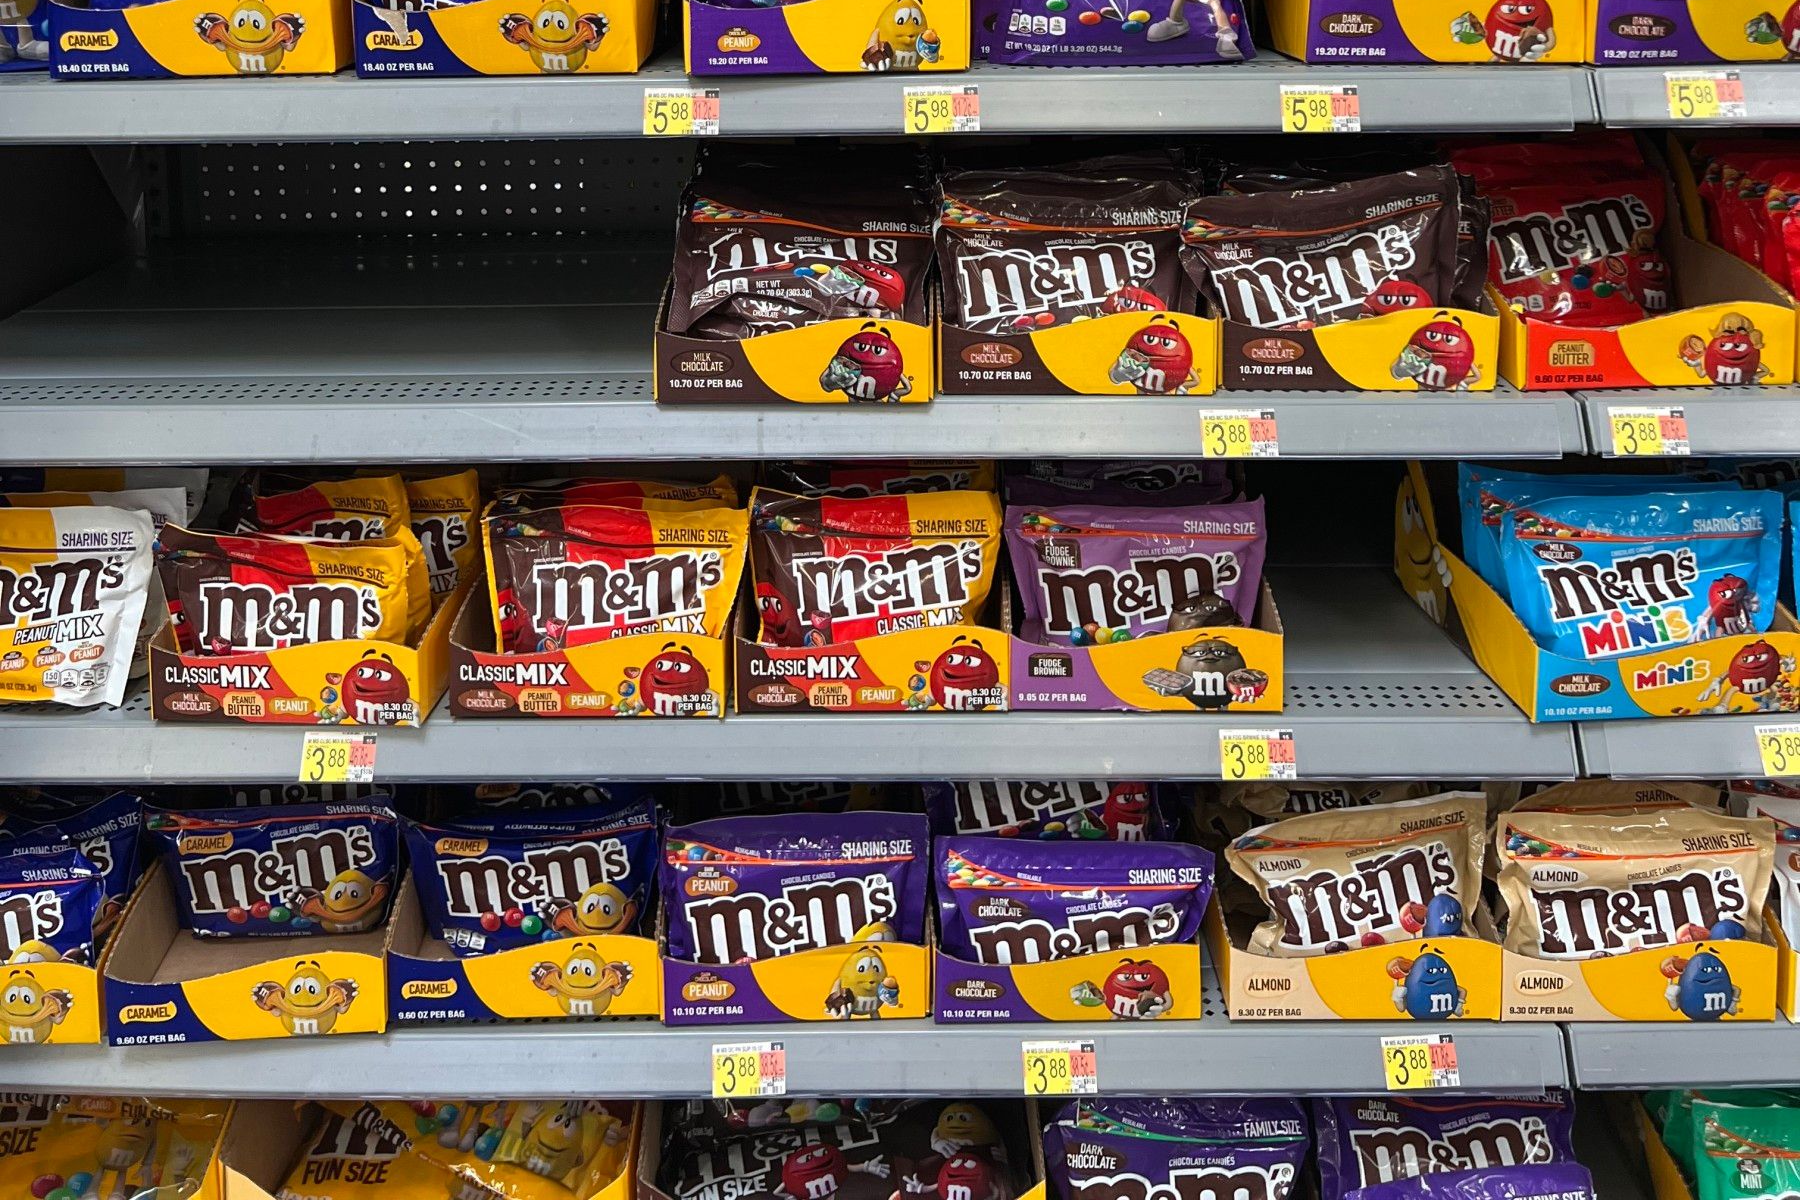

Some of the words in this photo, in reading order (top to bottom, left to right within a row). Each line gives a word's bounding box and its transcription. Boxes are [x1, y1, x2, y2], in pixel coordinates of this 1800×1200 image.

[1342, 15, 1362, 24] DARK
[1329, 23, 1373, 34] CHOCOLATE
[67, 34, 112, 48] CARAMEL
[723, 37, 755, 48] PEANUT
[57, 65, 79, 74] 18.40
[81, 64, 92, 73] OZ
[93, 64, 110, 73] PER
[111, 63, 129, 72] BAG
[1365, 198, 1413, 219] SHARING
[1415, 193, 1439, 207] SIZE
[1112, 210, 1159, 226] SHARING
[1160, 209, 1182, 225] SIZE
[862, 221, 907, 233] SHARING
[909, 223, 931, 234] SIZE
[755, 280, 768, 288] NET
[769, 280, 780, 288] WT
[1557, 344, 1585, 354] PEANUT
[693, 352, 711, 361] MILK
[1552, 353, 1590, 366] BUTTER
[681, 360, 724, 372] CHOCOLATE
[669, 379, 692, 388] 10.70
[693, 379, 704, 388] OZ
[705, 379, 724, 388] PER
[725, 379, 743, 388] BAG
[916, 520, 962, 534] SHARING
[964, 519, 987, 533] SIZE
[1183, 520, 1231, 535] SHARING
[1233, 521, 1256, 535] SIZE
[1693, 517, 1740, 533] SHARING
[1741, 515, 1763, 531] SIZE
[62, 532, 109, 548] SHARING
[111, 530, 134, 546] SIZE
[659, 529, 705, 543] SHARING
[707, 530, 729, 543] SIZE
[1045, 546, 1070, 557] FUDGE
[1129, 548, 1162, 557] CHOCOLATE
[1162, 546, 1187, 555] CANDIES
[318, 563, 366, 578] SHARING
[366, 566, 386, 582] SIZE
[1038, 659, 1062, 669] FUDGE
[1033, 666, 1067, 677] BROWNIE
[1571, 674, 1590, 684] MILK
[1558, 682, 1602, 694] CHOCOLATE
[182, 692, 200, 702] MILK
[231, 695, 256, 705] PEANUT
[861, 689, 896, 701] PEANUT
[172, 700, 212, 712] CHOCOLATE
[227, 704, 262, 716] BUTTER
[274, 700, 309, 712] PEANUT
[383, 703, 400, 712] 8.30
[401, 703, 413, 712] OZ
[379, 711, 396, 720] PER
[396, 711, 414, 721] BAG
[1400, 817, 1442, 834] SHARING
[1444, 810, 1466, 826] SIZE
[185, 836, 228, 851] CARAMEL
[442, 839, 482, 853] CARAMEL
[1681, 835, 1728, 851] SHARING
[1730, 832, 1755, 848] SIZE
[841, 841, 887, 858] SHARING
[889, 839, 913, 855] SIZE
[1258, 857, 1302, 873] ALMOND
[22, 868, 68, 883] SHARING
[1128, 869, 1176, 885] SHARING
[1178, 867, 1202, 883] SIZE
[1532, 870, 1579, 882] ALMOND
[691, 880, 730, 893] PEANUT
[990, 897, 1009, 907] DARK
[978, 906, 1022, 918] CHOCOLATE
[408, 983, 452, 996] CARAMEL
[966, 980, 986, 990] DARK
[1248, 978, 1291, 992] ALMOND
[1519, 978, 1564, 990] ALMOND
[689, 984, 728, 997] PEANUT
[955, 988, 997, 998] CHOCOLATE
[126, 1005, 172, 1020] CARAMEL
[942, 1010, 964, 1018] 10.10
[964, 1010, 976, 1018] OZ
[976, 1009, 992, 1018] PER
[993, 1009, 1010, 1018] BAG
[1509, 1006, 1526, 1015] 9.30
[1528, 1006, 1539, 1015] OZ
[1540, 1006, 1556, 1015] PER
[1557, 1006, 1574, 1015] BAG
[116, 1036, 136, 1045] 9.60
[136, 1035, 148, 1044] OZ
[149, 1035, 167, 1044] PER
[168, 1034, 186, 1043] BAG
[1367, 1100, 1388, 1111] DARK
[1357, 1108, 1400, 1123] CHOCOLATE
[1244, 1120, 1278, 1138] FAMILY
[1280, 1119, 1303, 1135] SIZE
[1080, 1142, 1103, 1156] DARK
[1067, 1154, 1117, 1169] CHOCOLATE
[1168, 1156, 1206, 1167] CHOCOLATE
[1207, 1155, 1236, 1166] CANDIES
[302, 1160, 341, 1184] FUN
[344, 1159, 392, 1184] SIZE
[1740, 1173, 1762, 1189] MINT
